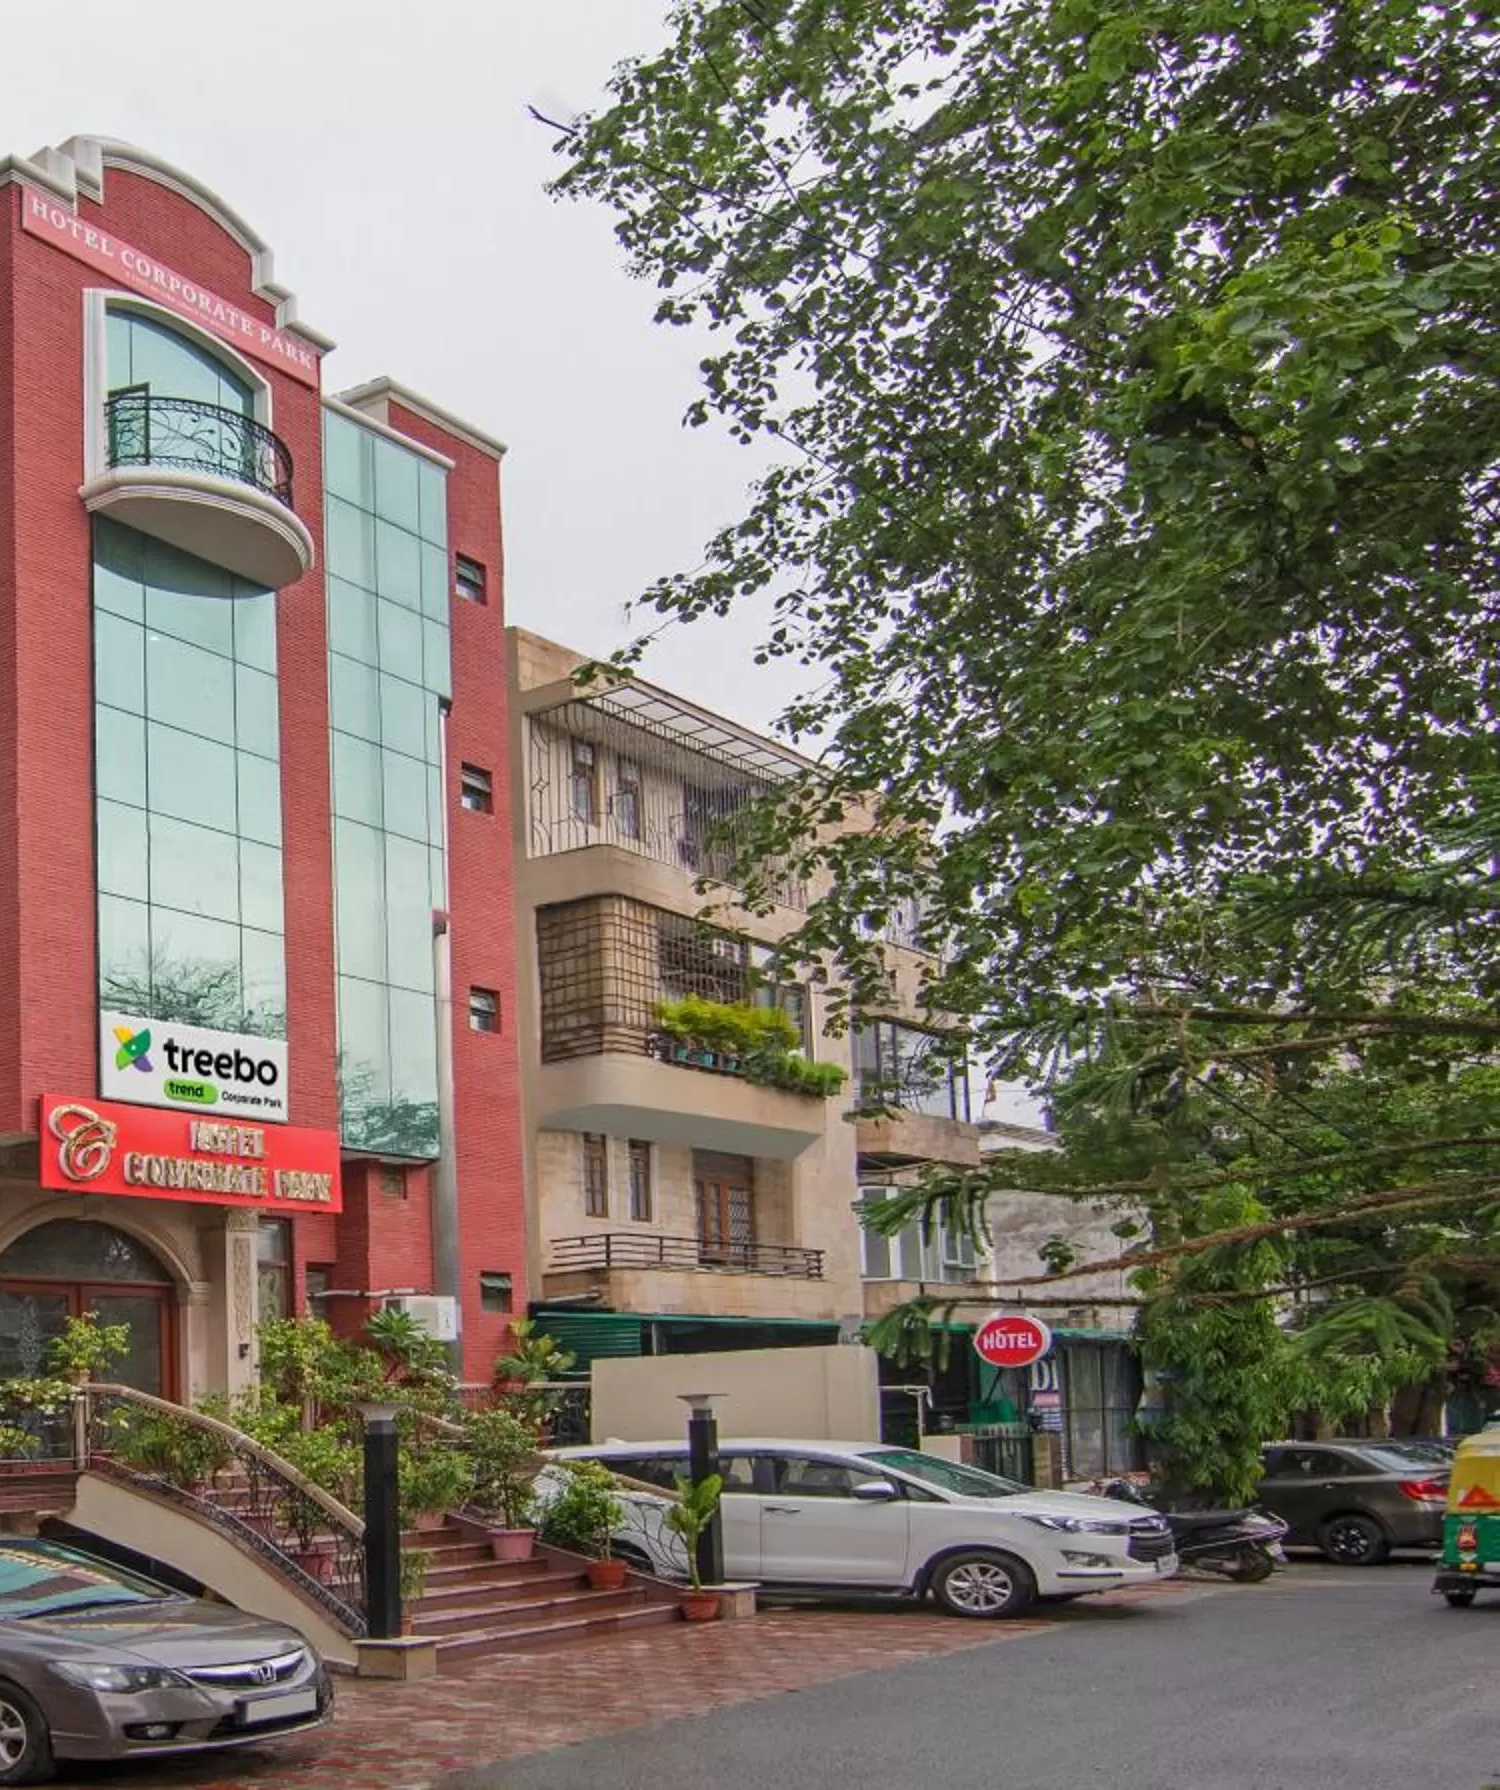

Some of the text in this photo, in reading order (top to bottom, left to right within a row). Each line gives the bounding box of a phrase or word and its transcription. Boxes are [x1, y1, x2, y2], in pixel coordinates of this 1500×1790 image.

[31, 198, 115, 257] HOTEL
[120, 249, 253, 338] CORPORATE
[260, 327, 313, 370] PARK
[163, 1037, 278, 1086] treebo
[169, 1081, 204, 1098] trend
[982, 1331, 1038, 1350] HOTEL
